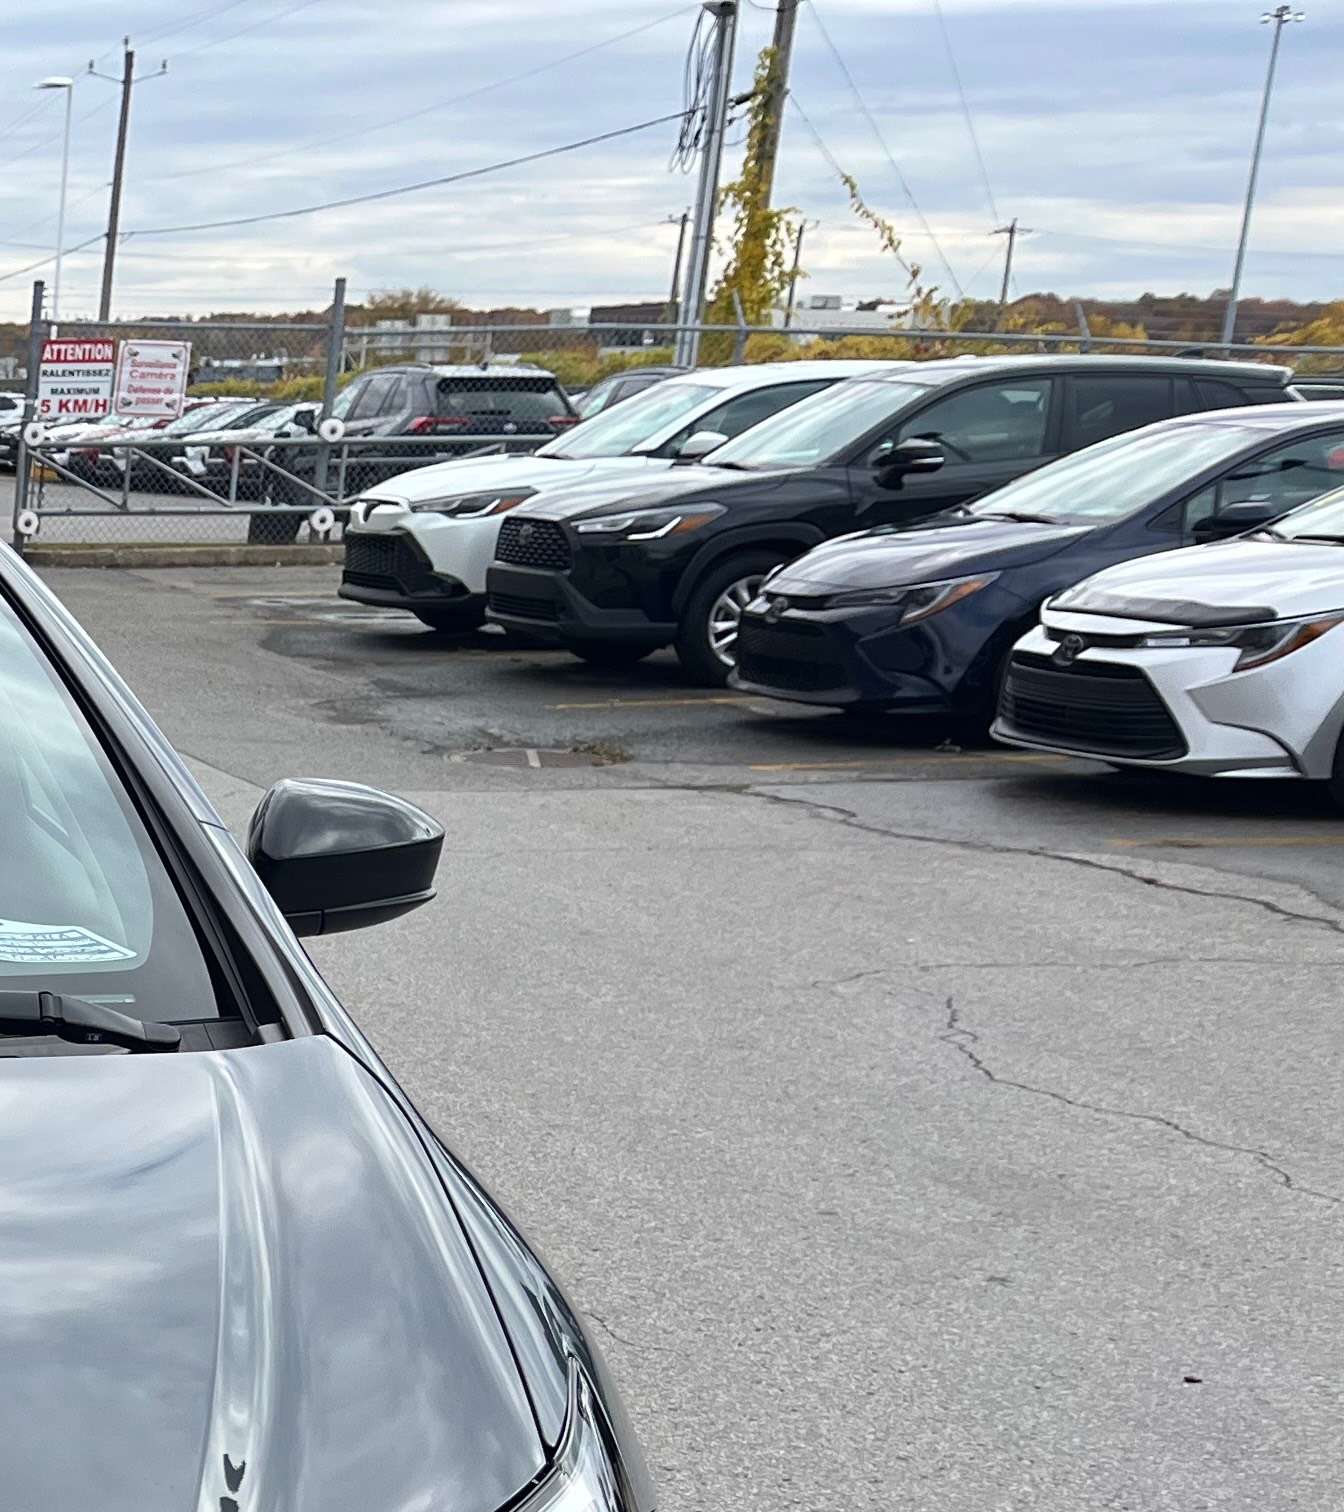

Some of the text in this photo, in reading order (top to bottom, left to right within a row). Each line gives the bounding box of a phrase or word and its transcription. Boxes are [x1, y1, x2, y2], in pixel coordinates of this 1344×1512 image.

[42, 343, 113, 361] ATTENTION
[41, 368, 111, 377] RALENTISSEZ
[50, 387, 101, 395] MAXIMUM
[40, 399, 108, 414] 5 KM/H
